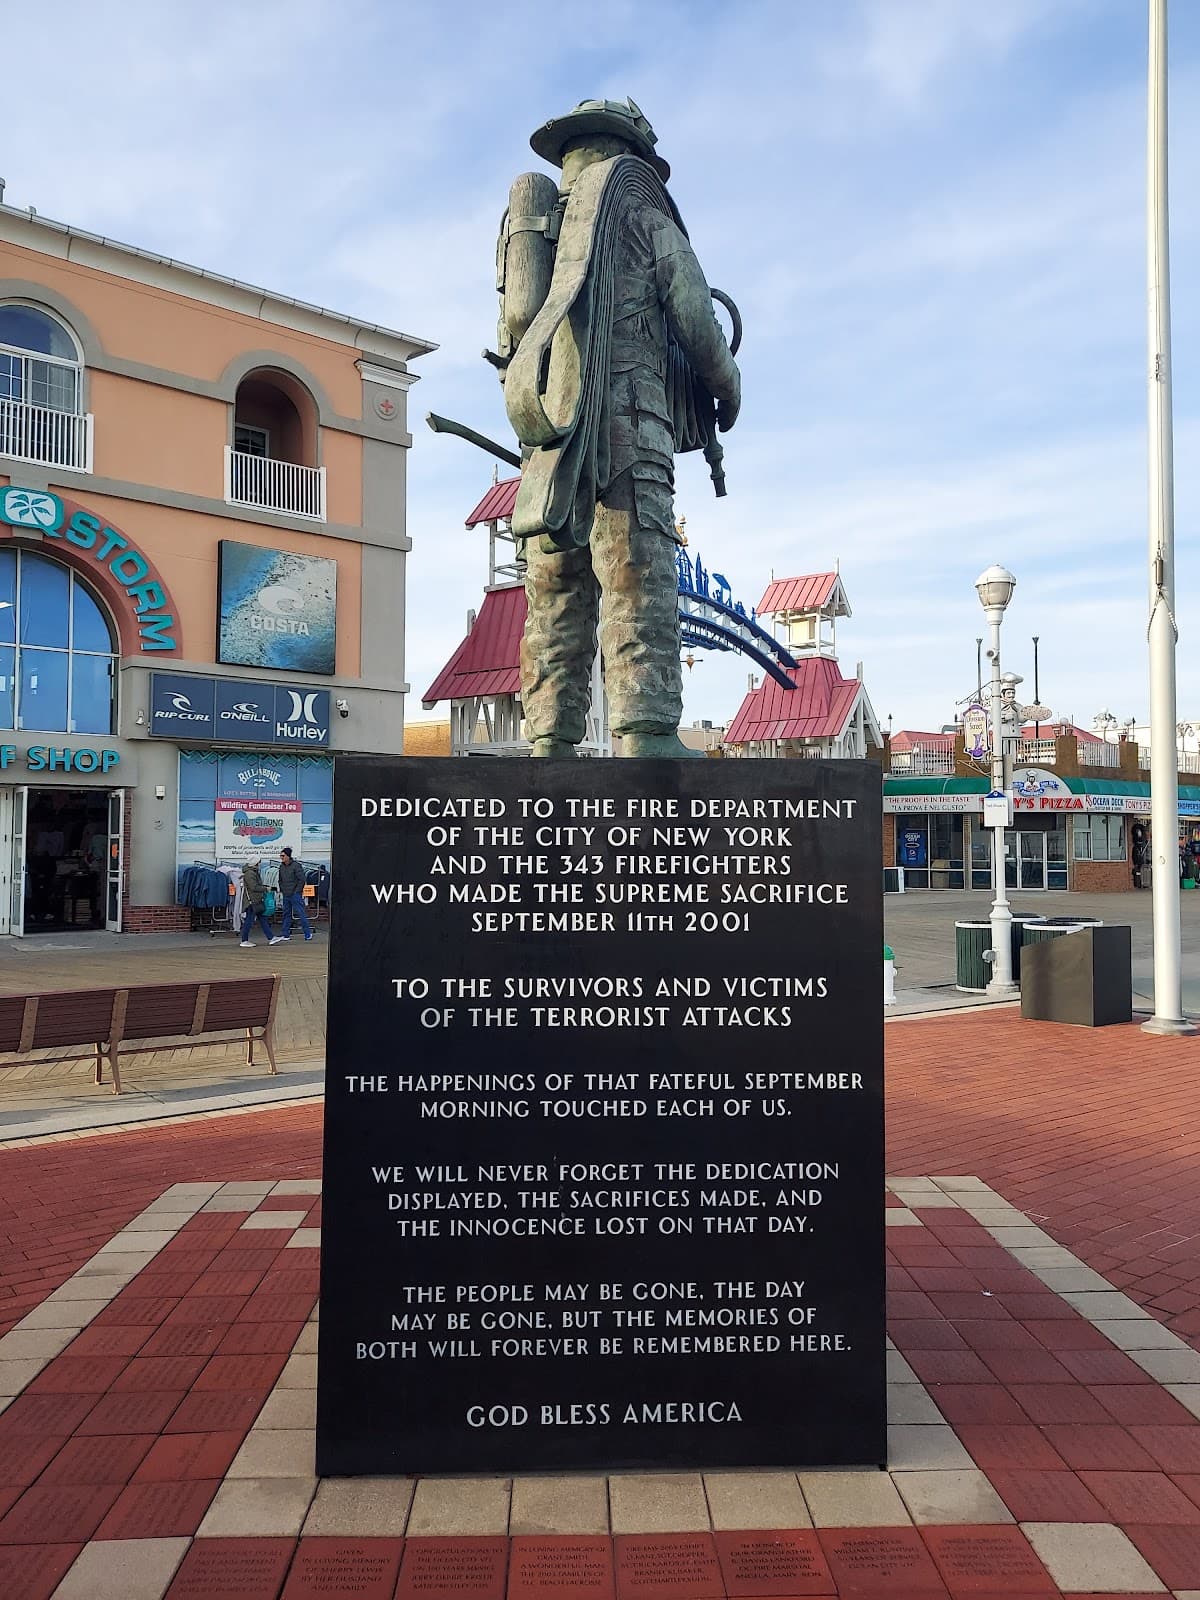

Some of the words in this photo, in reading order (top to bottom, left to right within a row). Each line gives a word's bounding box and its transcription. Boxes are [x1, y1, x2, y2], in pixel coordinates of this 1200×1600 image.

[65, 510, 177, 651] STORM
[250, 615, 309, 635] COSTA
[154, 710, 177, 719] RIP
[177, 711, 210, 721] CURL
[221, 711, 270, 722] O'NEILL
[276, 722, 326, 742] Hurley
[27, 746, 119, 773] SHOP
[221, 801, 248, 809] Wildfire
[249, 802, 283, 810] Fundraiser
[361, 797, 506, 818] DEDICATED
[517, 797, 554, 819] TO
[565, 798, 616, 818] THE
[626, 798, 679, 818] FIRE
[690, 798, 857, 819] DEPARTMENT
[1040, 797, 1084, 809] PIZZA
[1093, 797, 1110, 806] OCEAN
[1111, 797, 1124, 806] DECK
[255, 818, 284, 827] STRONG
[426, 826, 462, 847] OF
[473, 826, 525, 846] THE
[535, 826, 596, 847] CITY
[607, 826, 642, 847] OF
[653, 827, 711, 847] NEW
[723, 826, 793, 847] YORK
[429, 855, 487, 875] AND
[497, 855, 549, 875] THE
[559, 854, 604, 875] 343
[615, 854, 791, 876] FIREFIGHTERS
[370, 883, 437, 904] WHO
[449, 883, 522, 903] MADE
[533, 883, 584, 903] THE
[595, 882, 710, 904] SUPREME
[720, 883, 849, 905] SACRIFICE
[471, 911, 616, 933] SEPTEMBER
[627, 911, 674, 932] 11TH
[685, 911, 750, 932] 2001
[391, 977, 429, 999] TO
[440, 978, 492, 998] THE
[503, 976, 643, 999] SURVIVORS
[655, 977, 711, 997] AND
[722, 976, 828, 998] VICTIMS
[420, 1007, 456, 1028] OF
[467, 1007, 519, 1027] THE
[530, 1006, 671, 1028] TERRORIST
[681, 1006, 792, 1027] ATTACKS
[344, 1075, 389, 1093] THE
[398, 1073, 536, 1092] HAPPENINGS
[544, 1073, 574, 1091] OF
[583, 1073, 640, 1091] THAT
[649, 1073, 735, 1090] FATEFUL
[744, 1072, 864, 1090] SEPTEMBER
[421, 1100, 530, 1119] MORNING
[539, 1099, 647, 1118] TOUCHED
[656, 1099, 714, 1117] EACH
[723, 1098, 752, 1117] OF
[762, 1098, 792, 1117] US.
[371, 1166, 404, 1183] WE
[415, 1165, 469, 1183] WILL
[478, 1164, 549, 1182] NEVER
[559, 1163, 644, 1182] FORGET
[654, 1163, 697, 1181] THE
[706, 1162, 839, 1180] DEDICATION
[388, 1192, 508, 1211] DISPLAYED,
[517, 1191, 560, 1208] THE
[570, 1189, 690, 1209] SACRIFICES
[700, 1189, 766, 1207] MADE,
[775, 1189, 822, 1206] AND
[396, 1219, 440, 1237] THE
[450, 1217, 586, 1236] INNOCENCE
[595, 1216, 649, 1235] LOST
[658, 1216, 693, 1235] ON
[702, 1216, 758, 1234] THAT
[768, 1215, 814, 1233] DAY.
[402, 1286, 446, 1304] THE
[456, 1284, 535, 1303] PEOPLE
[545, 1283, 589, 1301] MAY
[599, 1283, 623, 1300] BE
[632, 1282, 704, 1301] GONE,
[713, 1281, 756, 1299] THE
[765, 1280, 805, 1298] DAY
[391, 1313, 437, 1331] MAY
[447, 1313, 471, 1330] BE
[480, 1311, 553, 1330] GONE,
[562, 1310, 603, 1329] BUT
[612, 1310, 656, 1327] THE
[665, 1307, 779, 1327] MEMORIES
[788, 1307, 817, 1326] OF
[356, 1341, 417, 1360] BOTH
[428, 1340, 481, 1358] WILL
[491, 1338, 589, 1357] FOREVER
[600, 1337, 623, 1355] BE
[633, 1335, 781, 1354] REMEMBERED
[790, 1334, 852, 1352] HERE.
[466, 1405, 528, 1428] GOD
[541, 1403, 610, 1425] BLESS
[622, 1401, 743, 1424] AMERICA
